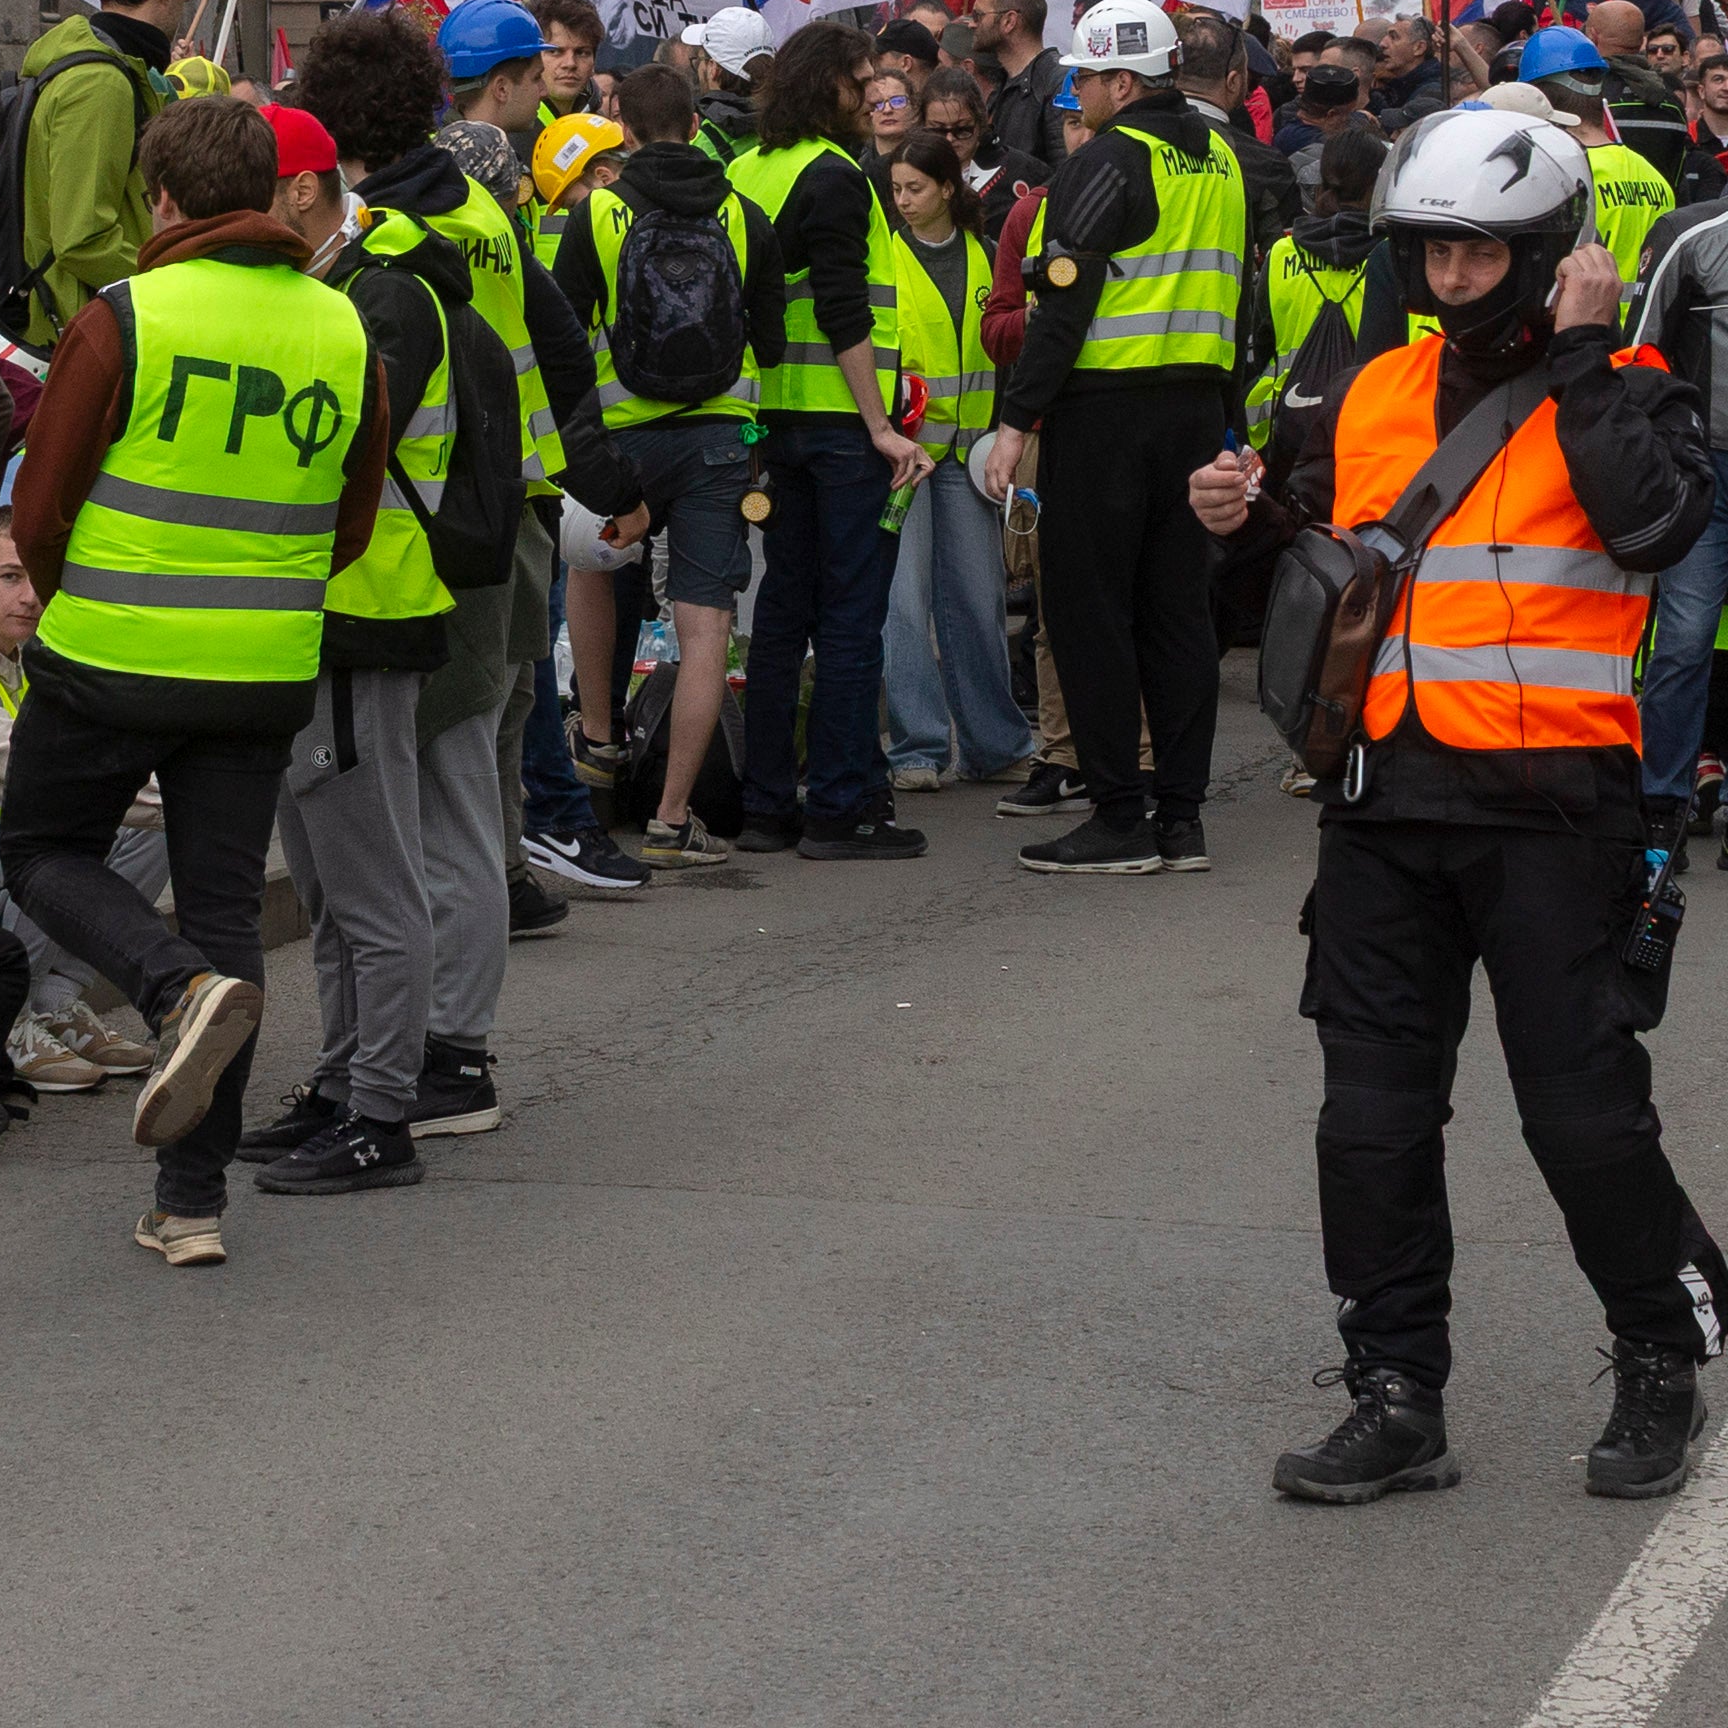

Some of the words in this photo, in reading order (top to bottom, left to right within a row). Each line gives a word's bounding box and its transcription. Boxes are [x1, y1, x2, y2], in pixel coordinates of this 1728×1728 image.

[1284, 7, 1349, 20] СМЕДЕРЕВО
[1598, 180, 1669, 210] МАШИНЦИ
[157, 355, 342, 468] ГРФ
